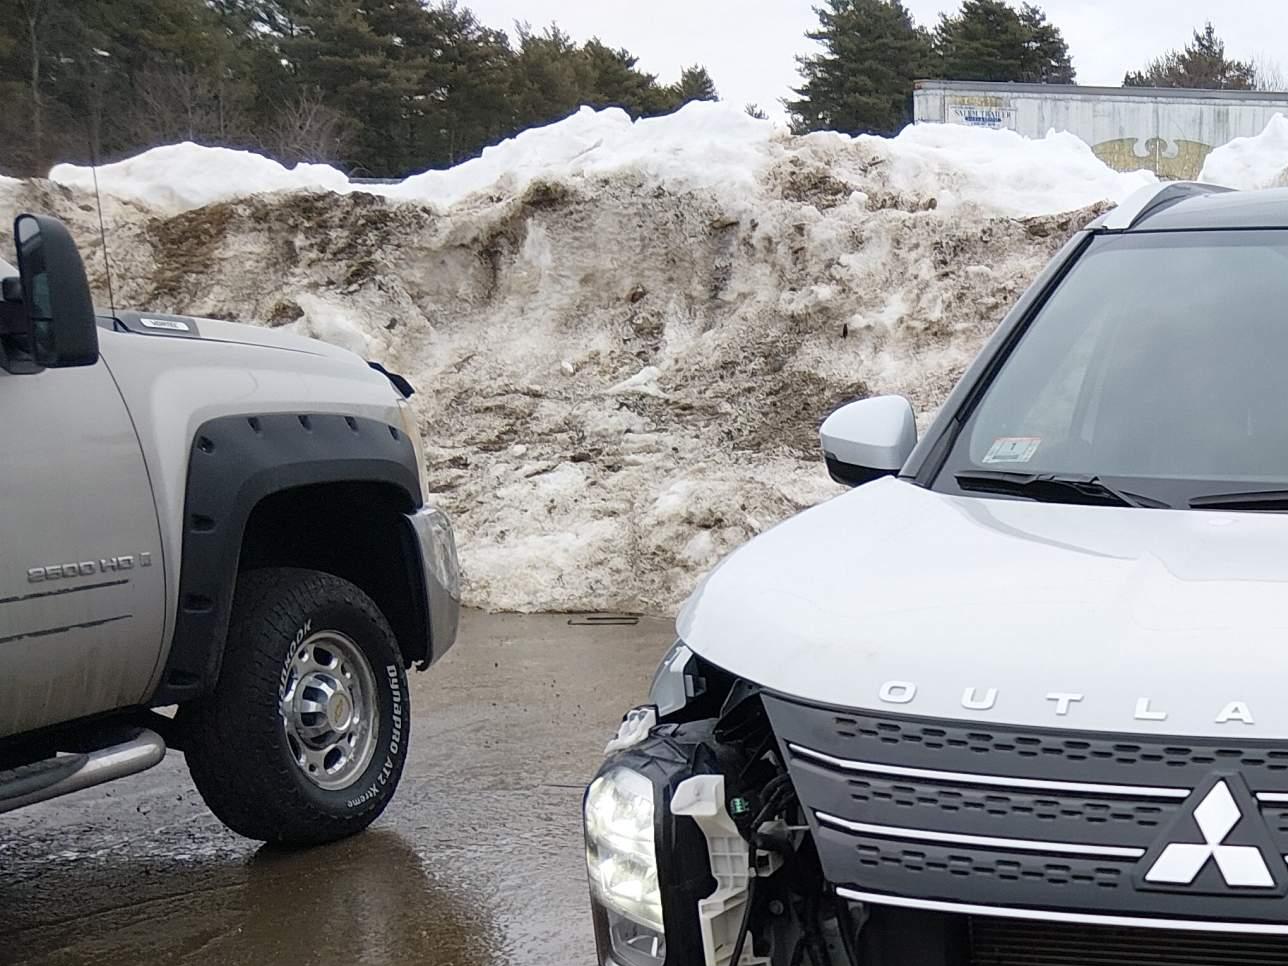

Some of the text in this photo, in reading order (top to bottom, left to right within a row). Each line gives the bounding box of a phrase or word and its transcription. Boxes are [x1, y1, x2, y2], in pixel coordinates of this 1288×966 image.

[27, 555, 135, 584] 2500 HD
[377, 755, 394, 786] AT2
